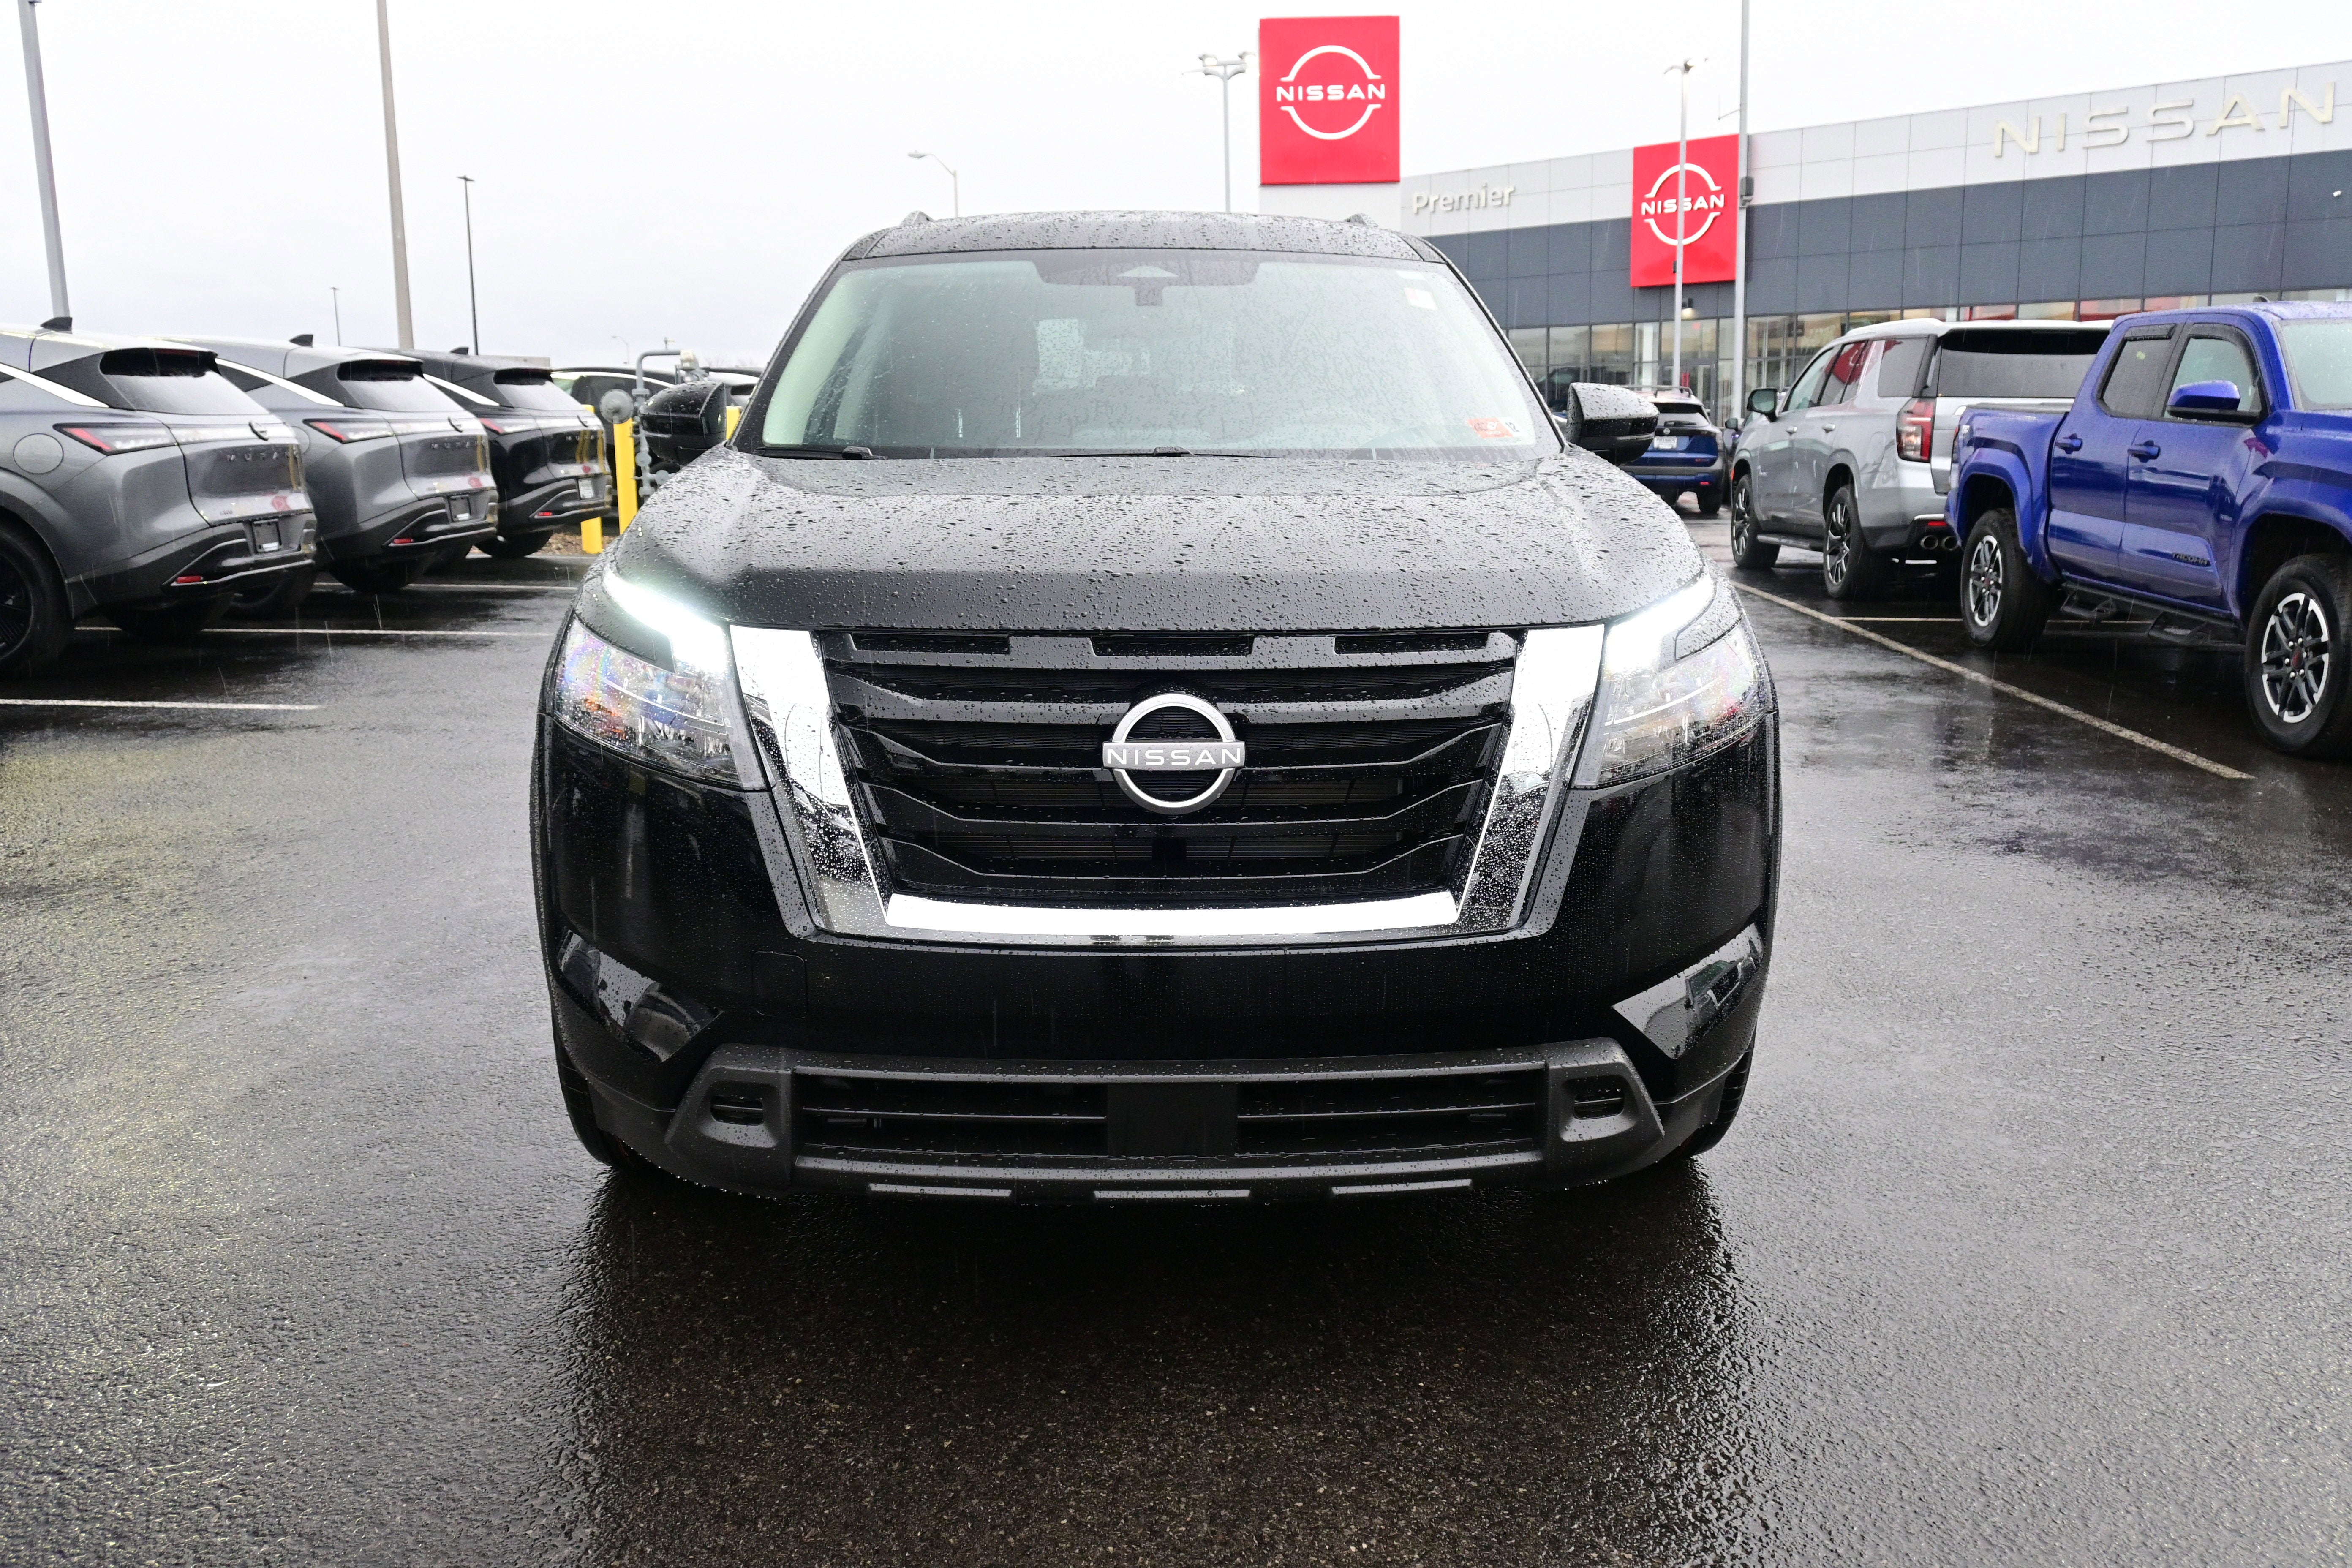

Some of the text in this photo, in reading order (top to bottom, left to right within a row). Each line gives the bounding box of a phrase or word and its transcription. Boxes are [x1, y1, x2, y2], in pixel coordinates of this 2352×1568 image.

[1276, 84, 1386, 102] NISSAN
[1994, 81, 2336, 158] NISSAN
[1413, 182, 1516, 215] Premier
[1641, 194, 1725, 215] NISSAN
[1107, 747, 1241, 765] NISSAN
